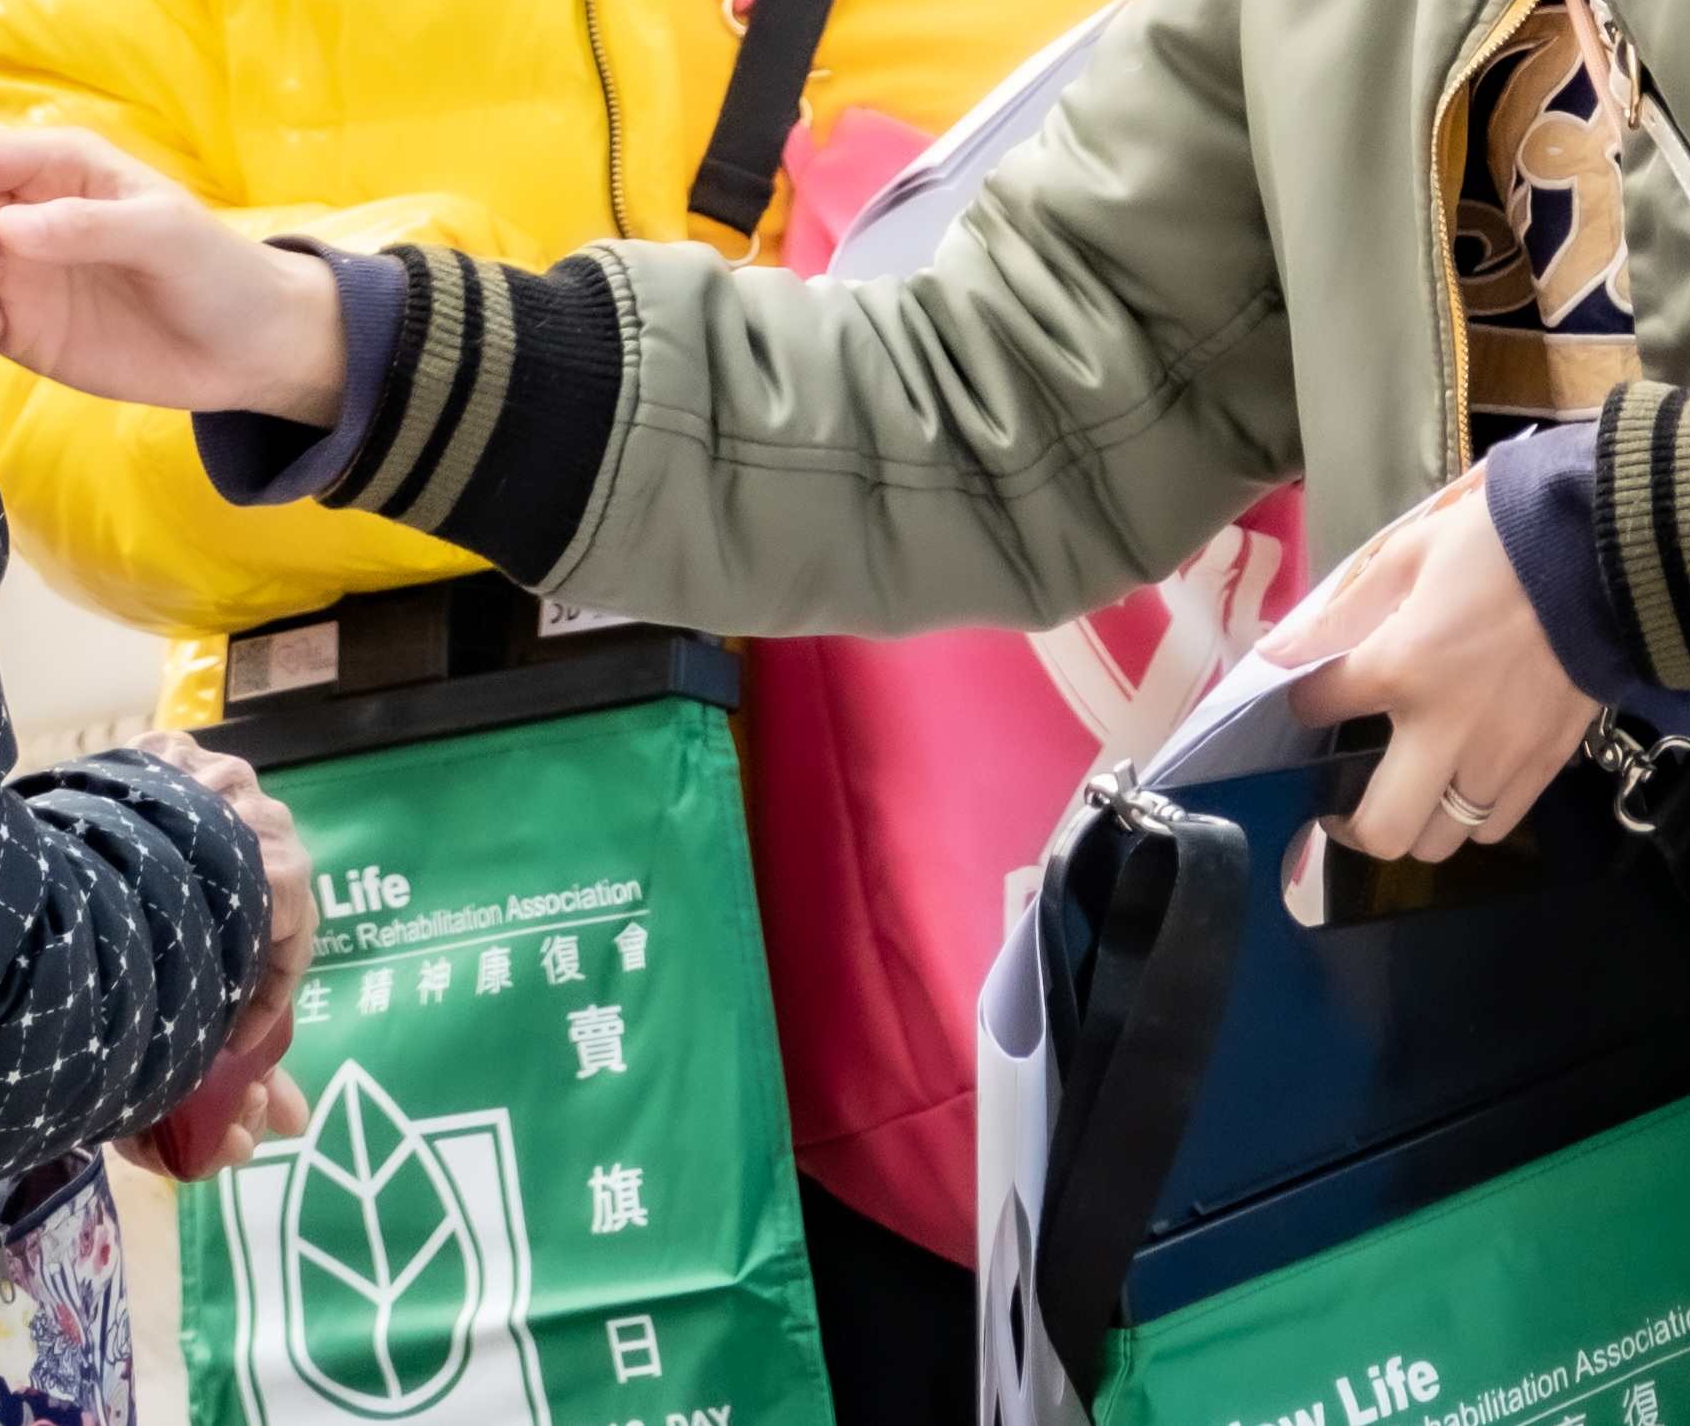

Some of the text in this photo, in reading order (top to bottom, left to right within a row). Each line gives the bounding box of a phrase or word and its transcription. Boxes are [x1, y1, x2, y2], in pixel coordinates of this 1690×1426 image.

[317, 865, 411, 919] Life
[356, 904, 503, 950] Rehabilitation
[505, 879, 644, 922] Association
[297, 922, 649, 1025] 生精神康復會
[566, 1004, 663, 1384] 賣旗日
[1335, 1355, 1441, 1426] Life
